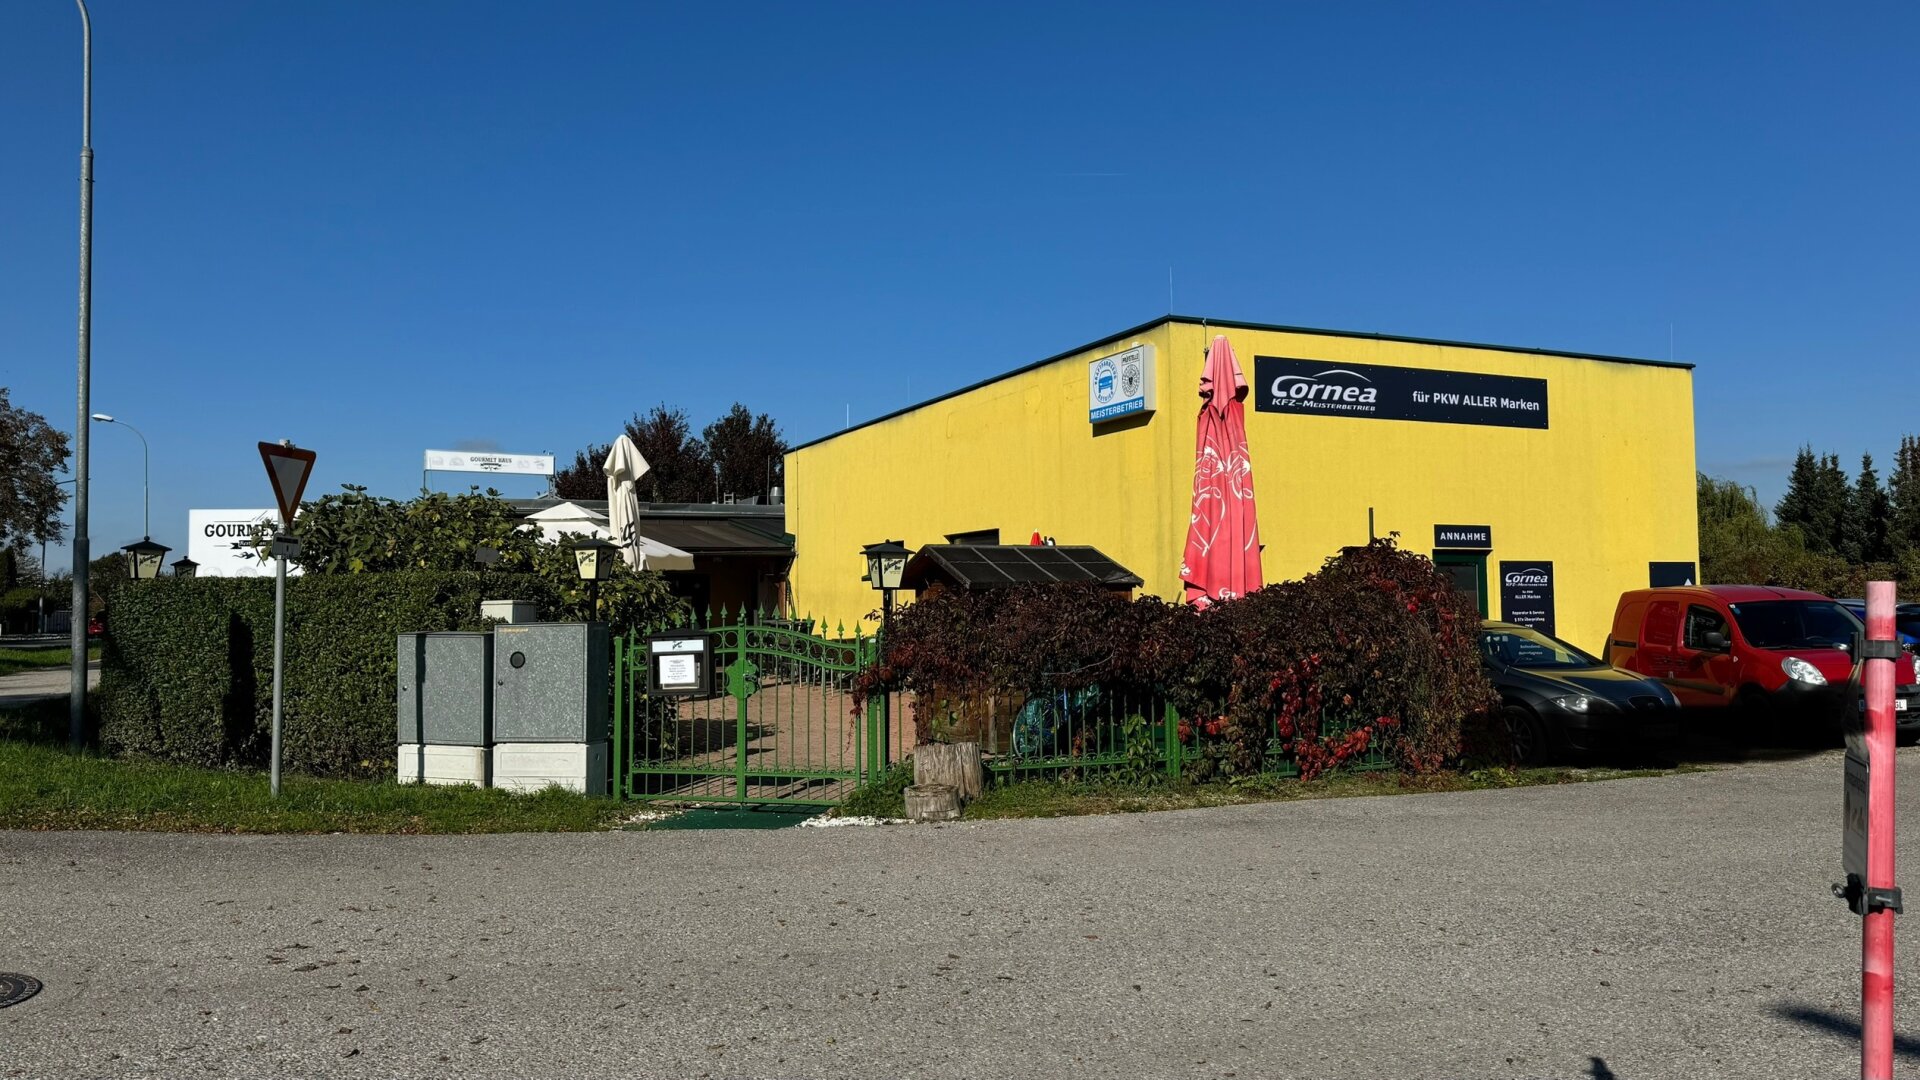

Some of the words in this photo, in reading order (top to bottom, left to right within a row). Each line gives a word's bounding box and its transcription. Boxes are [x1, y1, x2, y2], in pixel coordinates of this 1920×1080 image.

[1270, 374, 1377, 404] Cornea
[1091, 399, 1143, 419] MEISTERBETRIEB
[1412, 390, 1431, 404] für
[1433, 392, 1459, 405] PKW
[1462, 394, 1498, 408] ALLER
[1500, 397, 1540, 411] Marken
[1440, 532, 1486, 541] ANNAHME
[1505, 572, 1548, 583] Cornea
